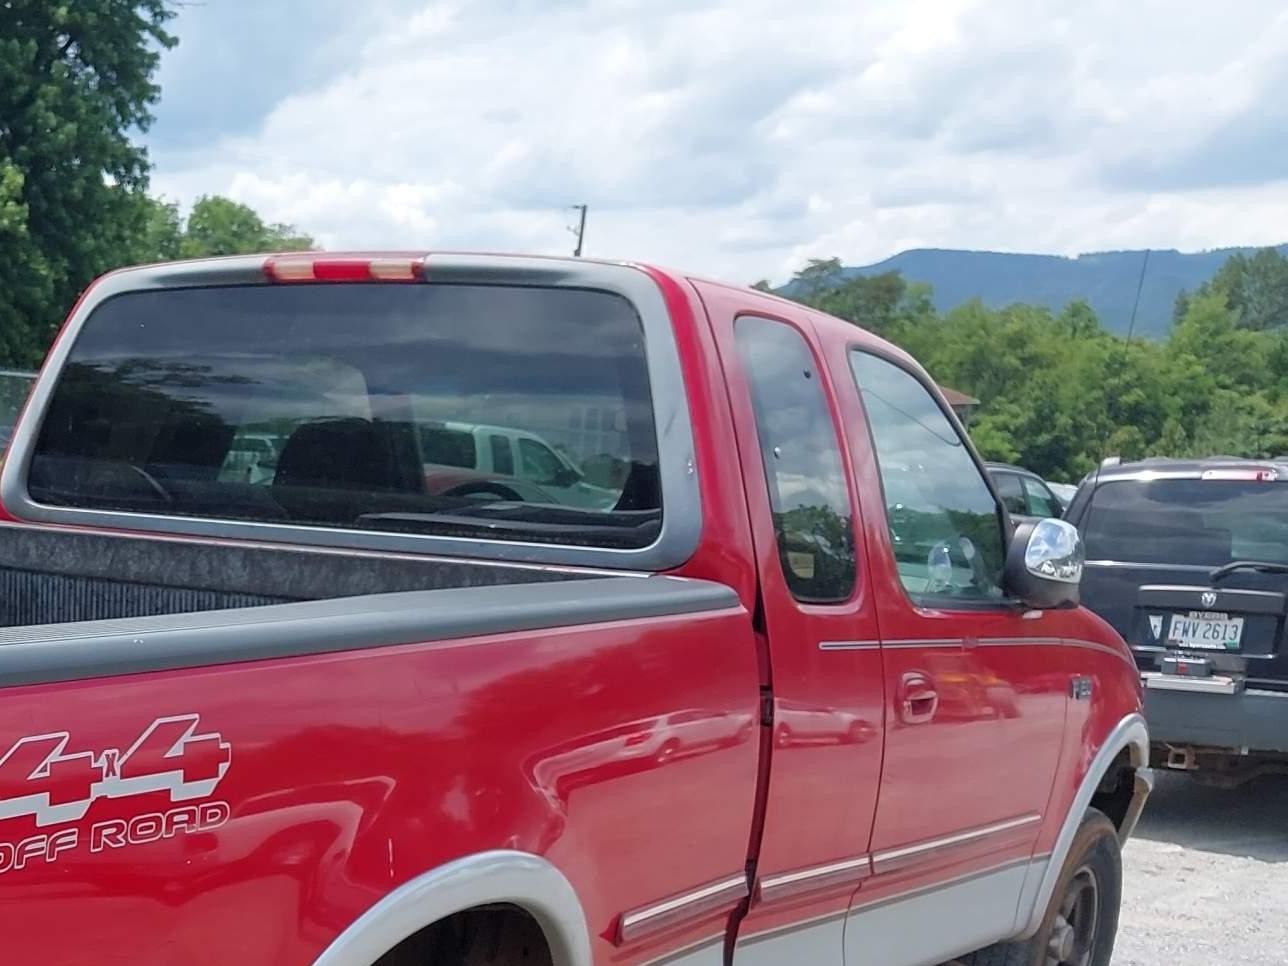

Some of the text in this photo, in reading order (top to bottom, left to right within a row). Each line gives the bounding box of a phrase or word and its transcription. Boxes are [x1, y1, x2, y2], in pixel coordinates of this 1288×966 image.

[1172, 620, 1239, 641] FWV 2613
[90, 801, 230, 852] ROAD
